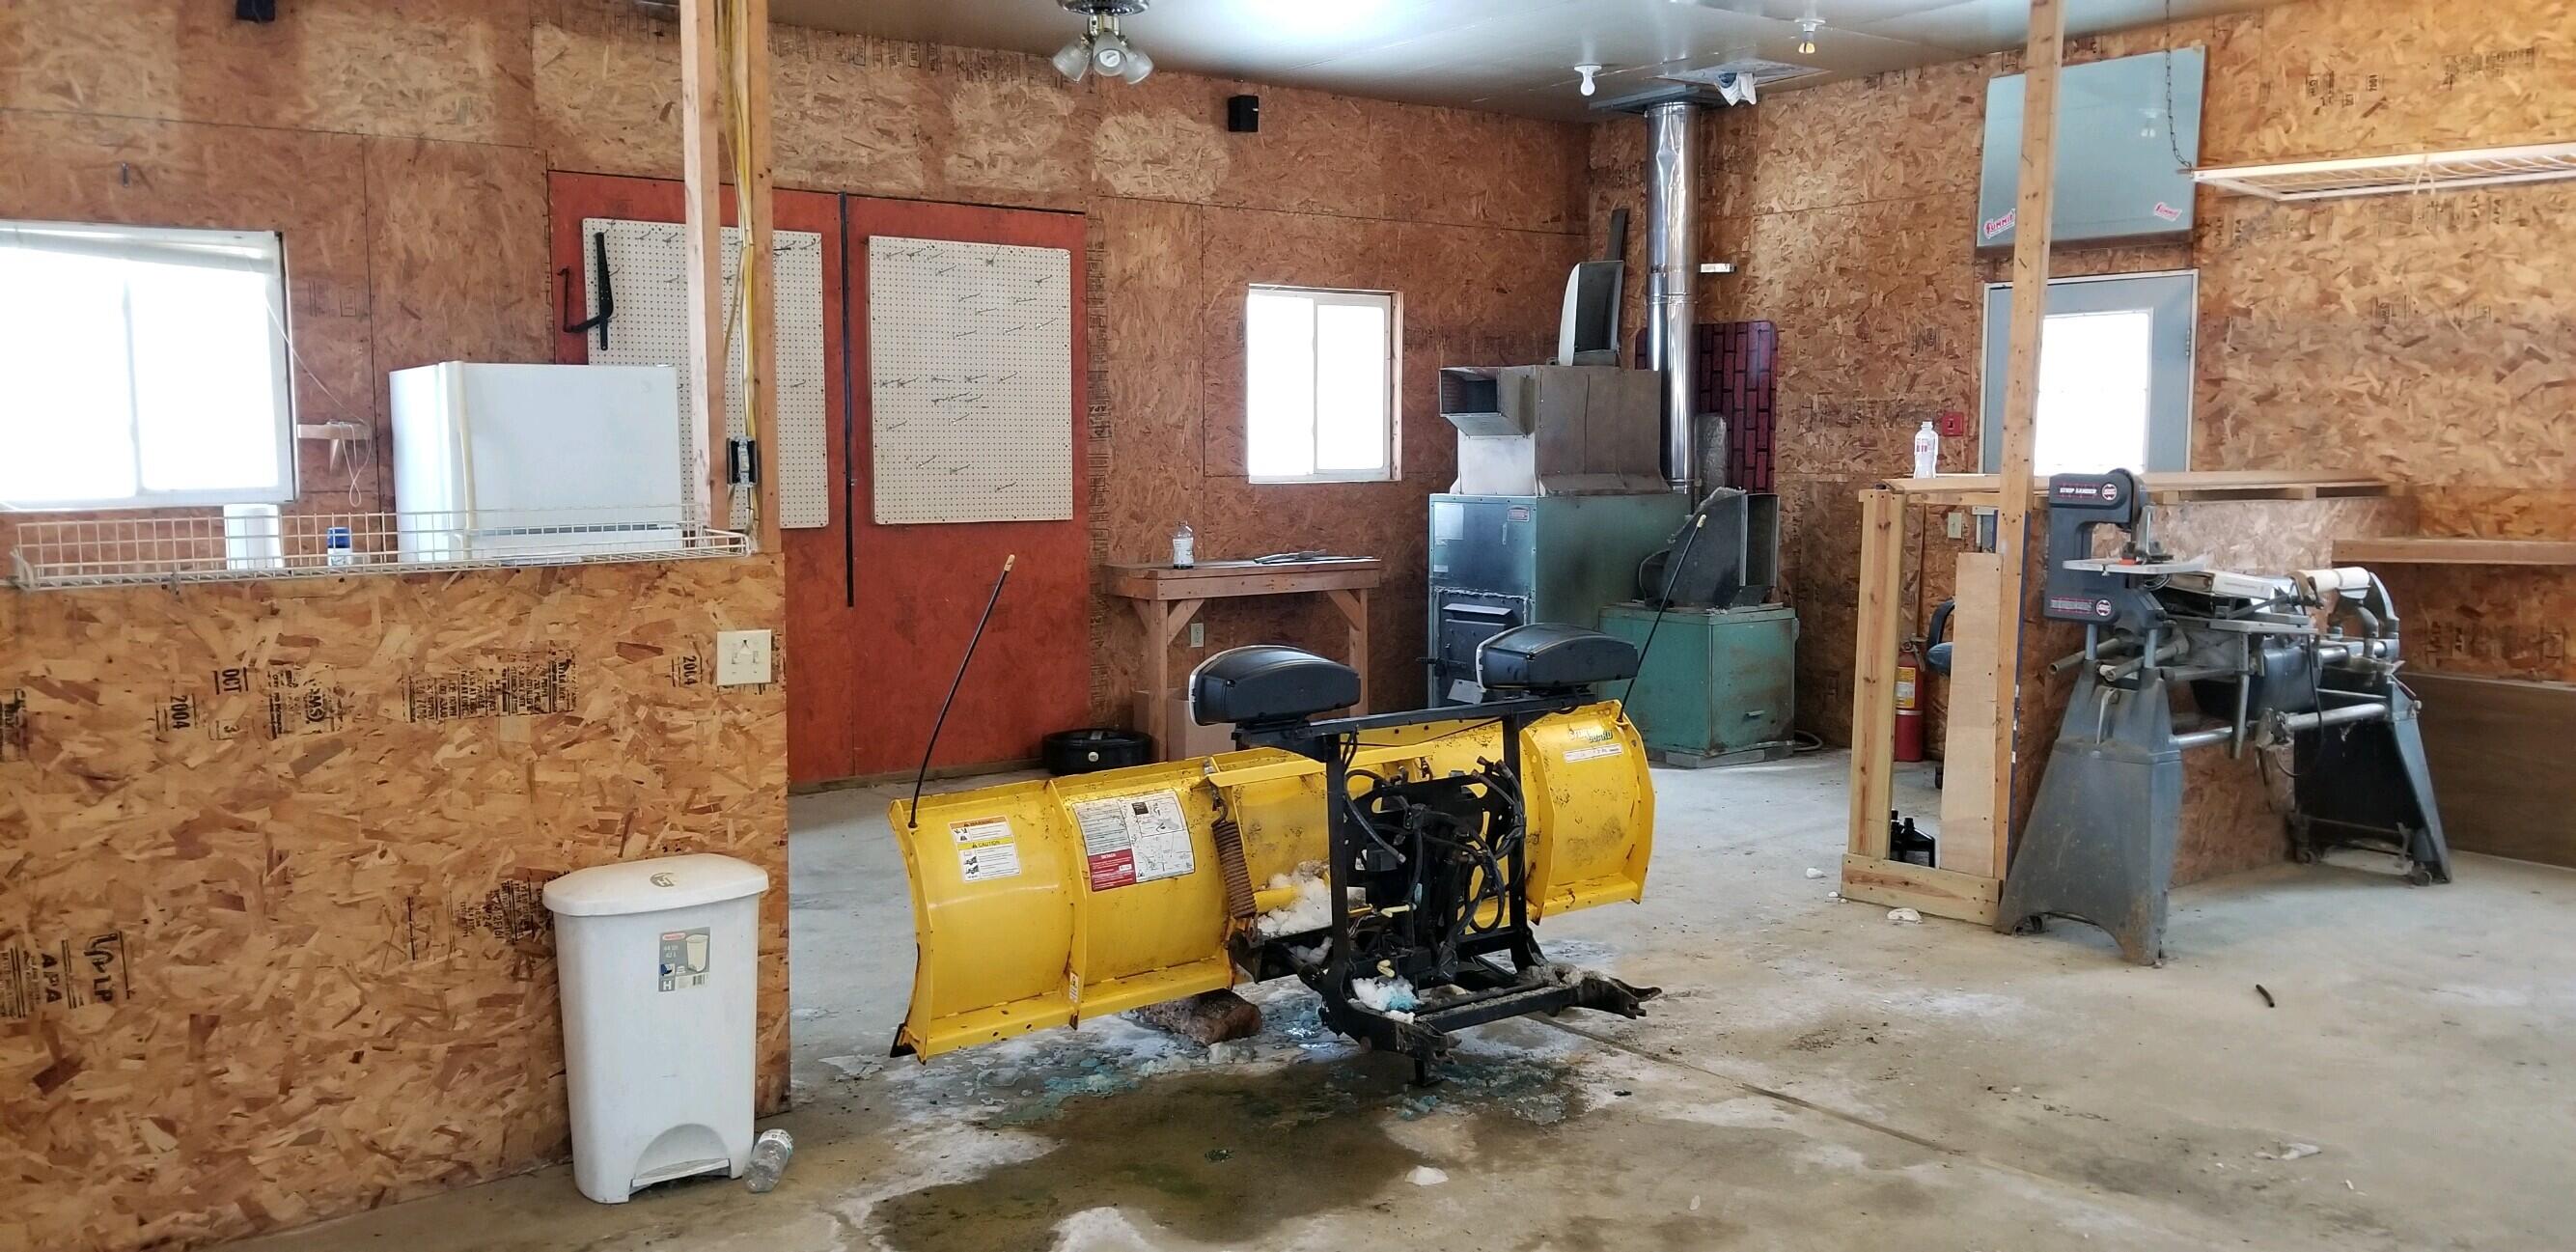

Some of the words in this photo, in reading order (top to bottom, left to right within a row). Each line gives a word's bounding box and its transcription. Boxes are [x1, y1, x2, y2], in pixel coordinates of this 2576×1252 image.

[221, 668, 241, 692] OCT
[170, 694, 191, 730] 2004
[41, 953, 62, 1003] APA
